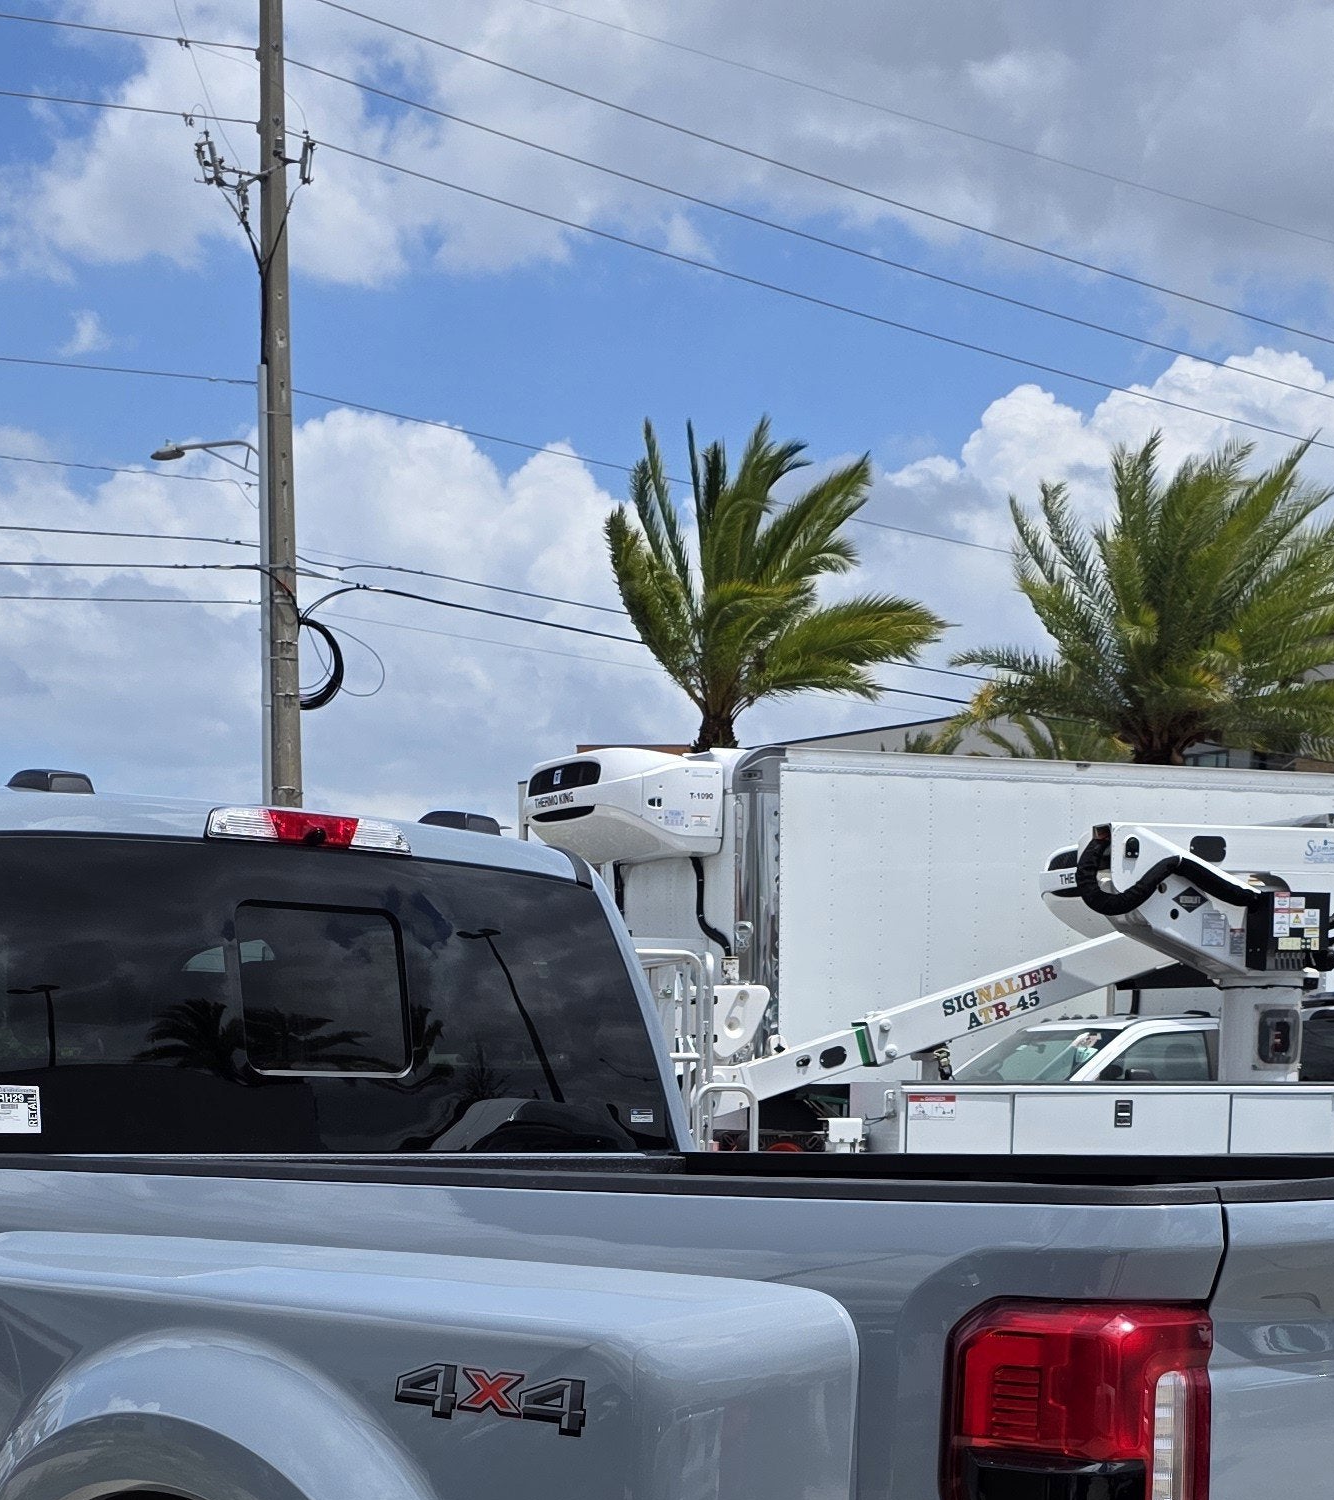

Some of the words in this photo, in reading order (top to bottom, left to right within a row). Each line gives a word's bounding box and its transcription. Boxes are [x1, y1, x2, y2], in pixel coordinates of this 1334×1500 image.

[942, 964, 1058, 1017] SIGNALIER
[967, 990, 1040, 1030] ATR-45
[28, 1095, 38, 1127] RETAIL
